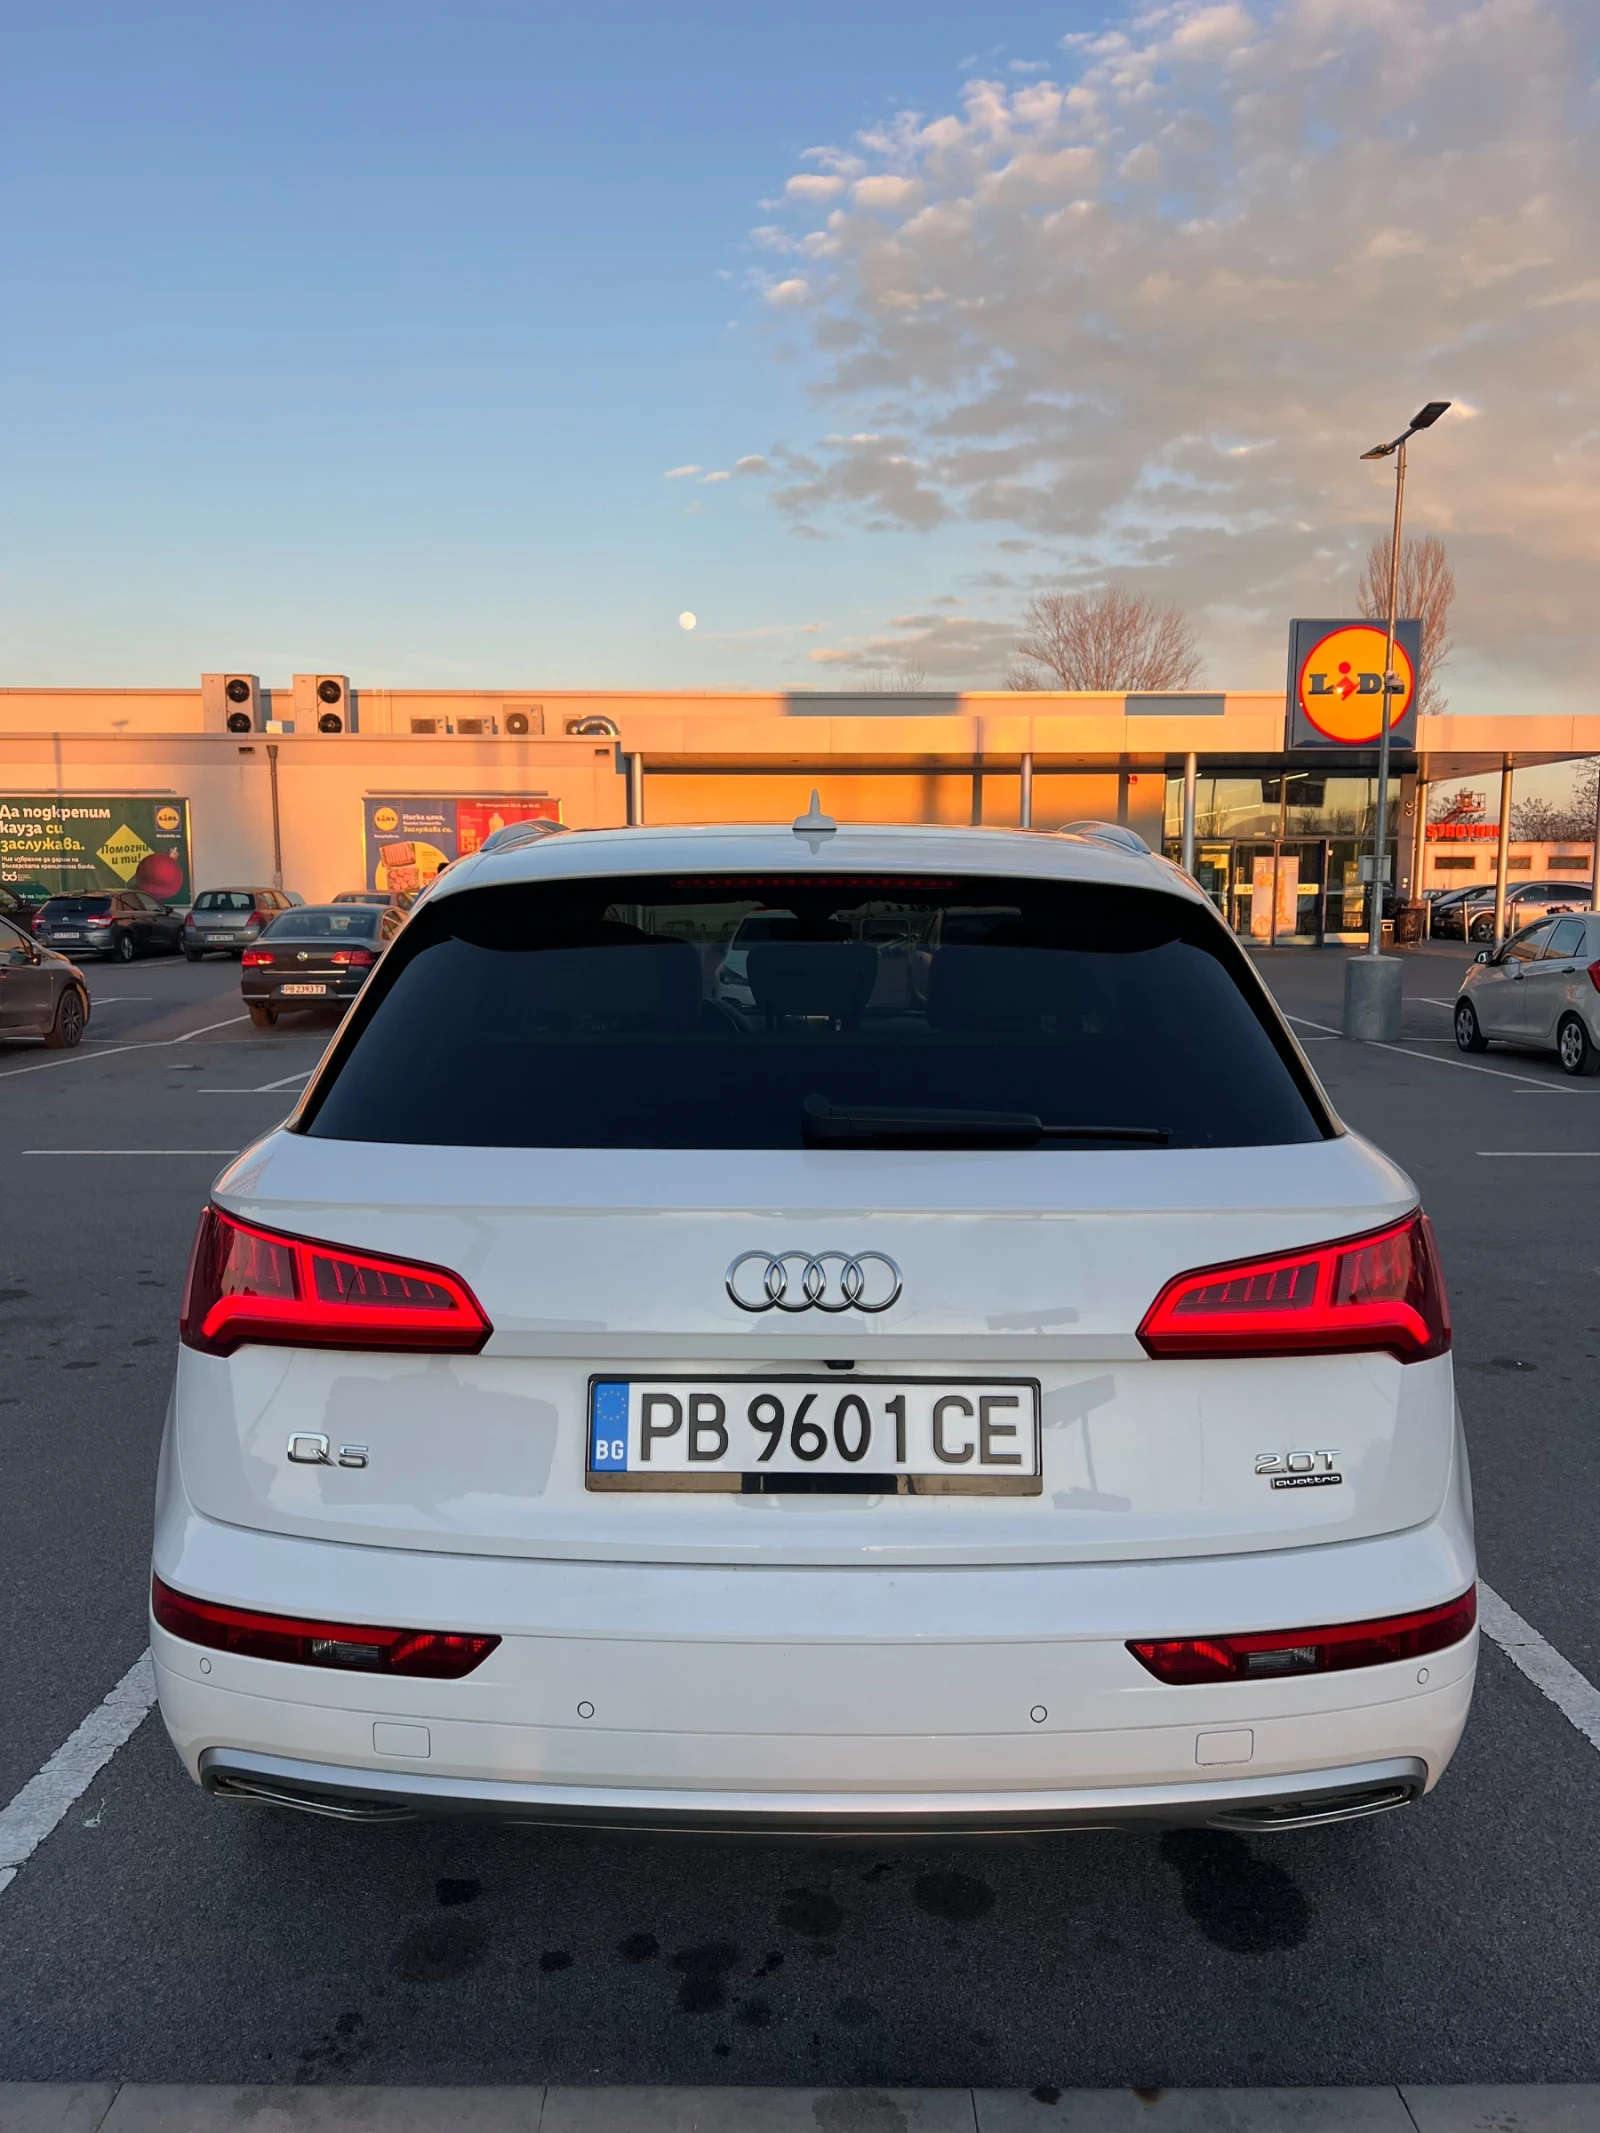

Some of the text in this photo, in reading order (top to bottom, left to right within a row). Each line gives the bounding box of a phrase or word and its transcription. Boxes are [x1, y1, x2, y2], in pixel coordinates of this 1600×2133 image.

[0, 805, 111, 821] Да подкрепим
[0, 820, 64, 837] кауза си
[0, 837, 85, 853] заслужава.
[101, 844, 149, 855] Помогни
[111, 857, 118, 865] и
[640, 1393, 1022, 1465] PB 9601 CE
[287, 1431, 369, 1469] Q5
[595, 1439, 625, 1461] BG
[1255, 1449, 1342, 1475] 2.0T
[1276, 1475, 1340, 1487] quattro
